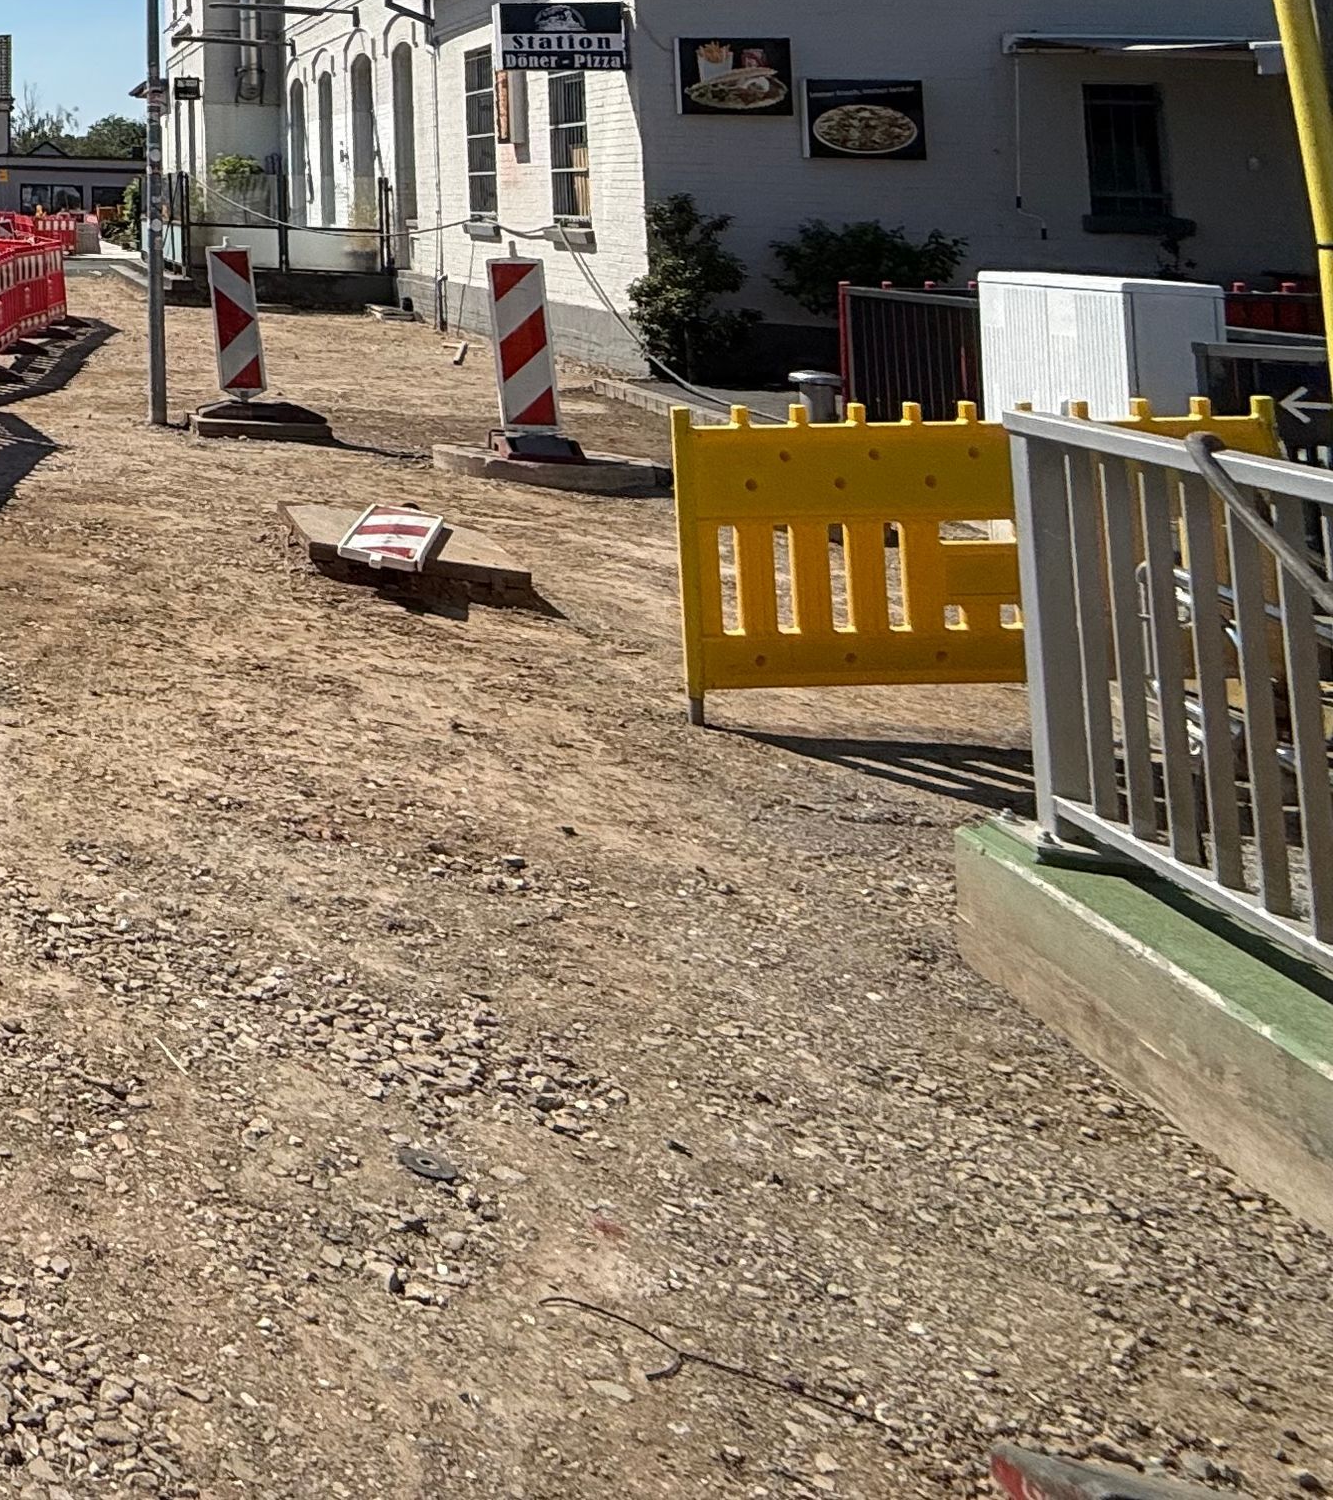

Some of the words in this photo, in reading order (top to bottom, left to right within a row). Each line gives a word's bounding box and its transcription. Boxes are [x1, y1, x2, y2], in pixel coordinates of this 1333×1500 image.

[512, 35, 612, 50] Station
[504, 53, 559, 68] Döner
[573, 53, 621, 68] Pizza
